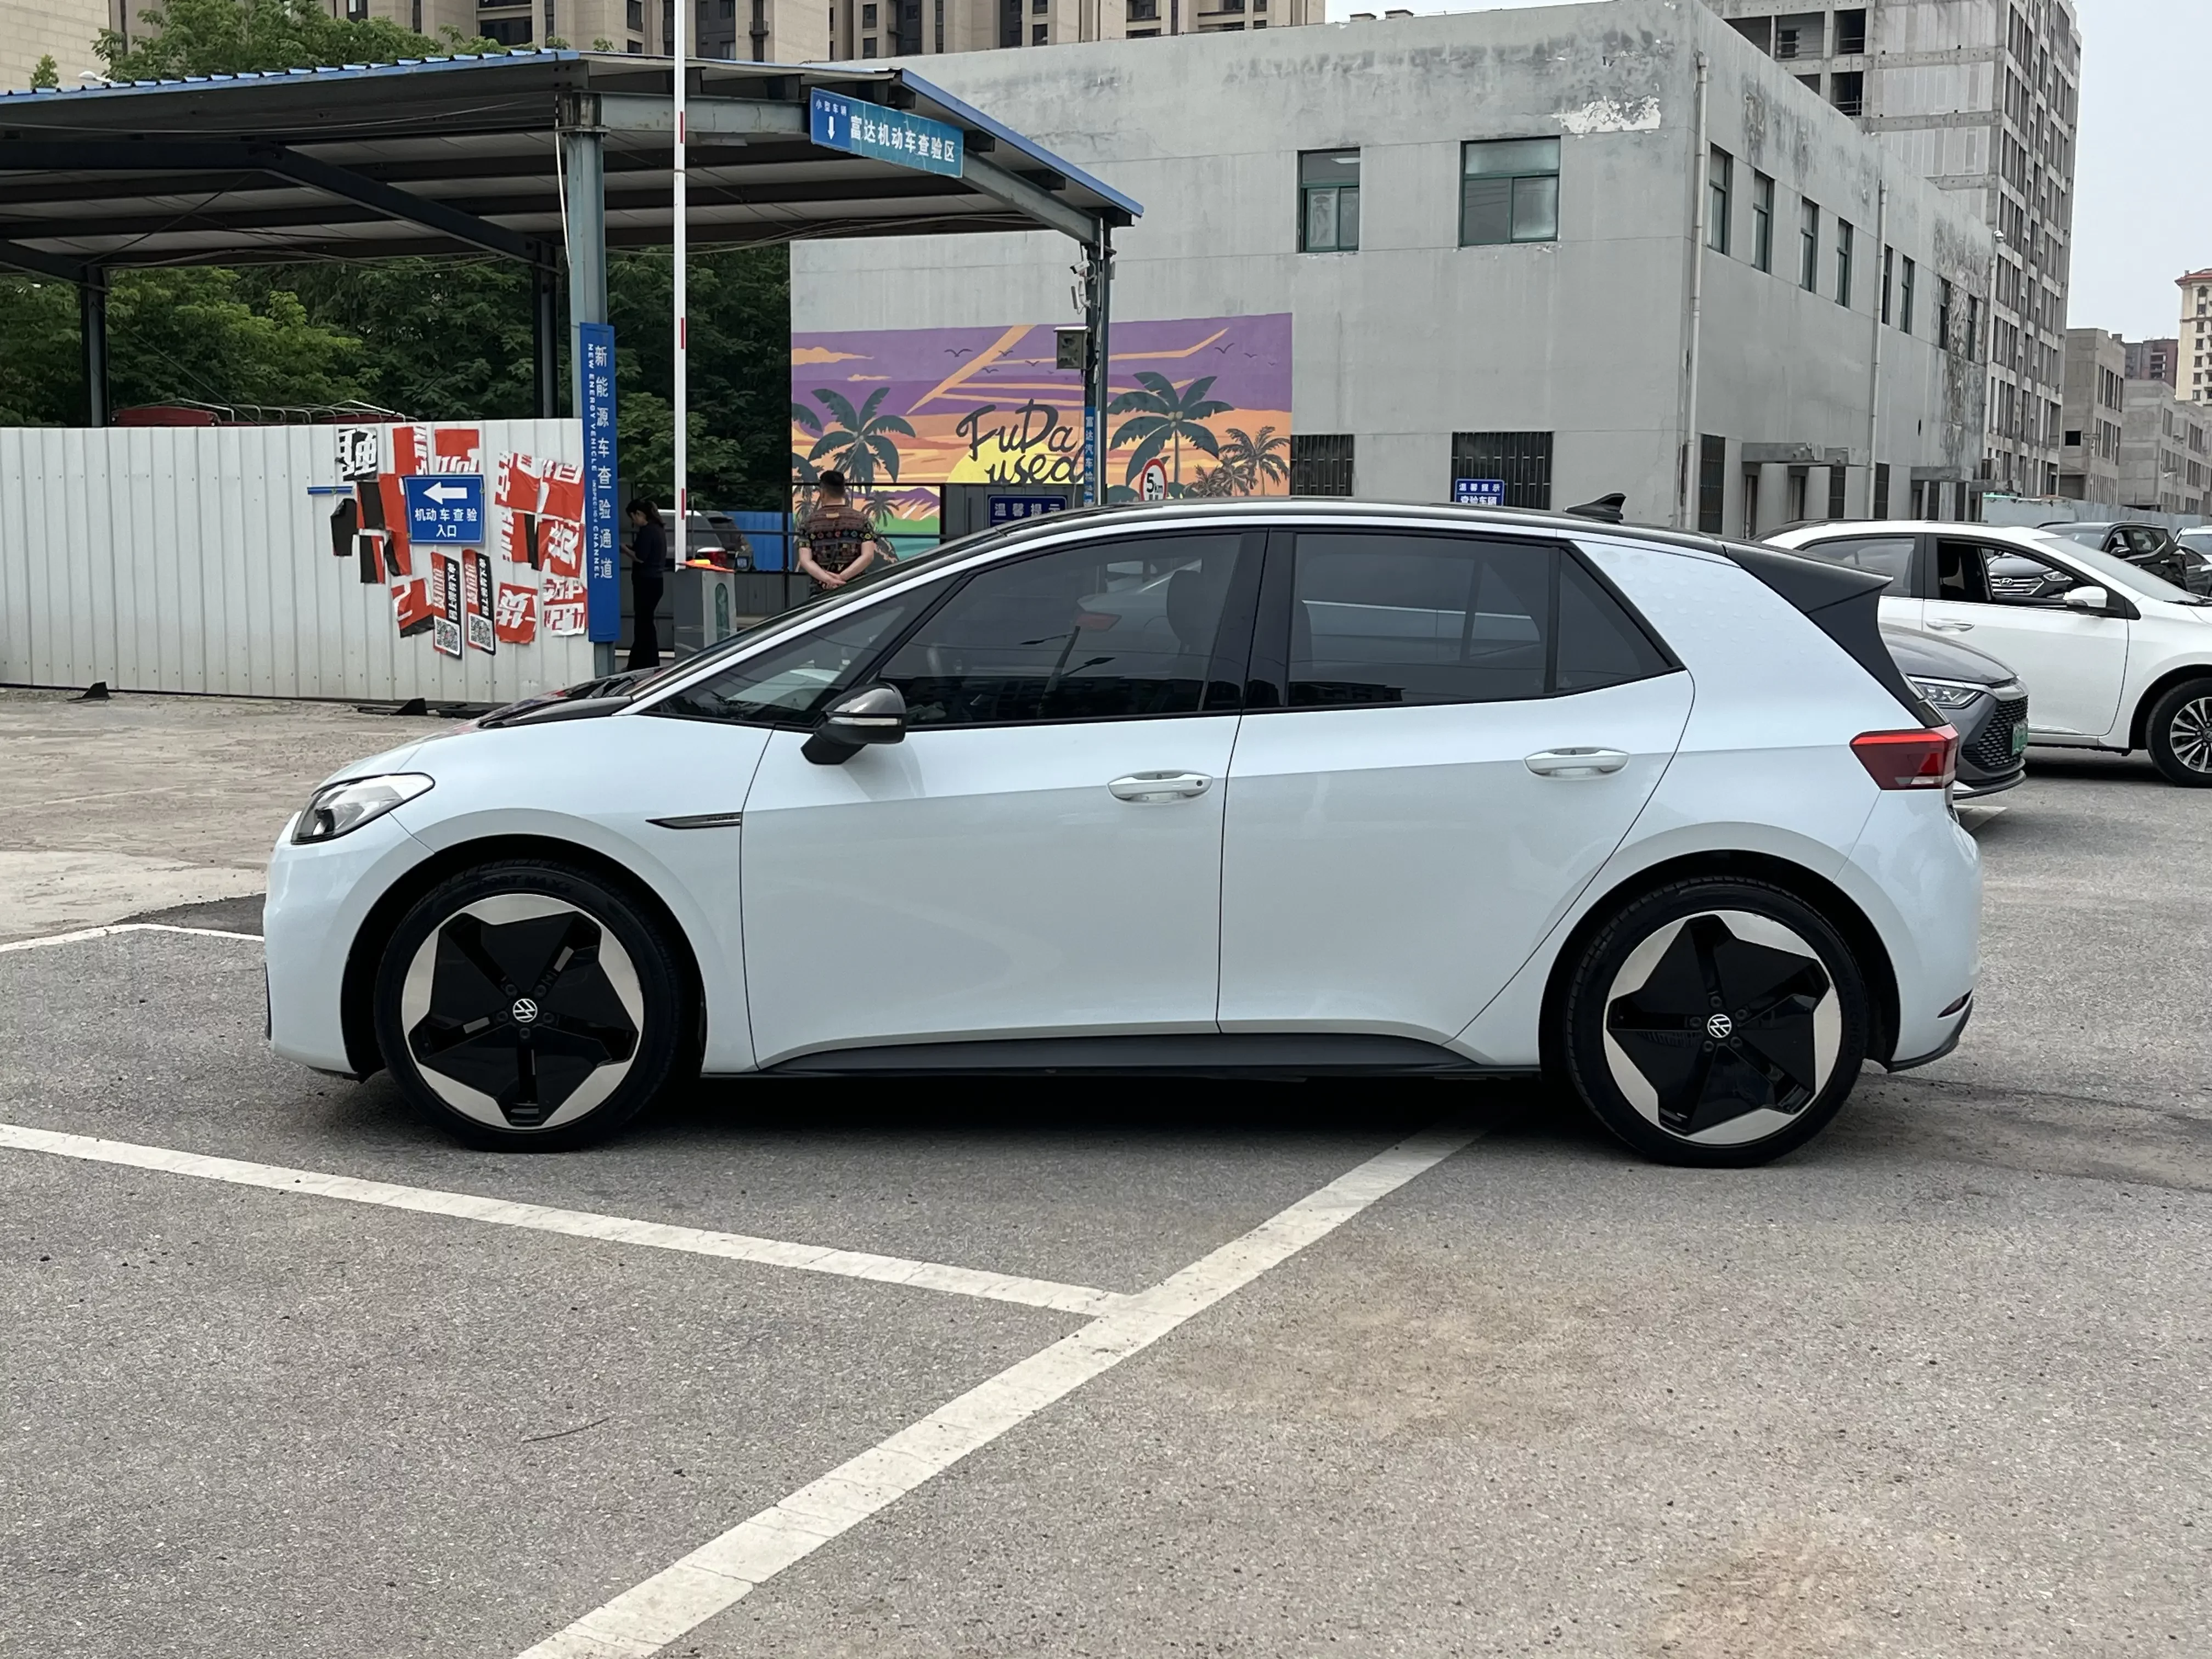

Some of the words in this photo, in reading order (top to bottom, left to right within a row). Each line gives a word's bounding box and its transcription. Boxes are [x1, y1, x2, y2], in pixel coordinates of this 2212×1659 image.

[850, 115, 955, 162] 富达机动车查验区
[956, 398, 1078, 461] FuDa
[595, 346, 612, 579] 新能源车查验通道
[414, 507, 478, 522] 机动车查验
[436, 524, 457, 538] 入口
